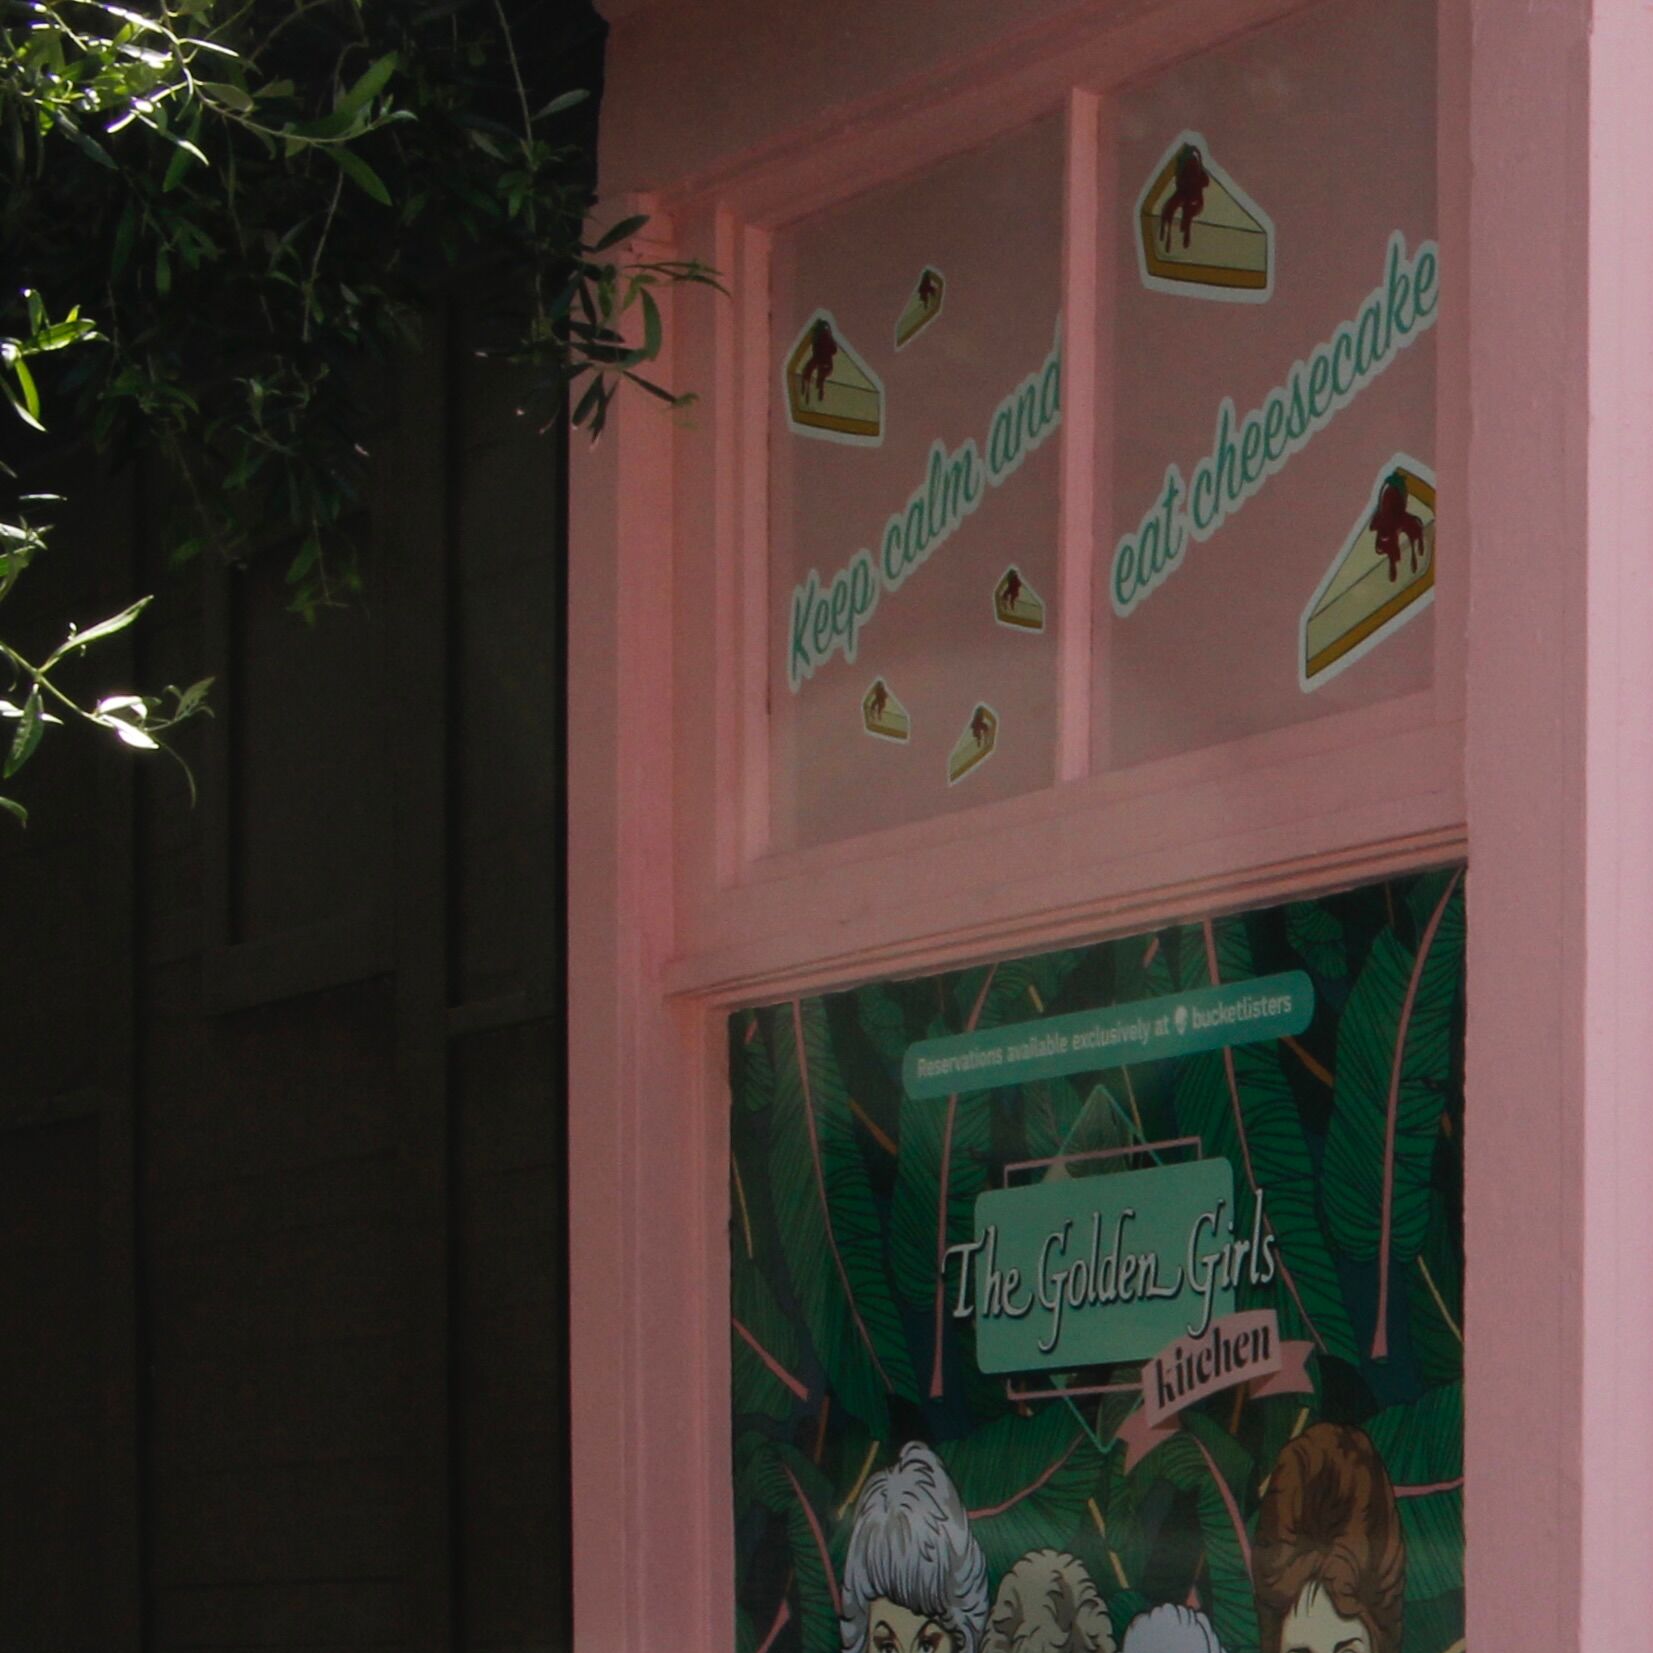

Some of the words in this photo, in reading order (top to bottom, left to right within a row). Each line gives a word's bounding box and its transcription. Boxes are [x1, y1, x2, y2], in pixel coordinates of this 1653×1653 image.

[1115, 476, 1184, 605] eat
[1192, 242, 1438, 530] cheesecake
[791, 557, 874, 682] Keep
[883, 449, 980, 580] calm
[917, 1047, 1003, 1079] Reservations
[1007, 1032, 1068, 1062] available
[1072, 1017, 1150, 1050] exclusively
[1154, 1016, 1170, 1036] at
[1192, 994, 1292, 1029] bucketlisters
[942, 1225, 1033, 1318] The
[1037, 1208, 1183, 1351] Golden
[1187, 1189, 1276, 1338] Girls
[1156, 1325, 1270, 1408] kitchen
